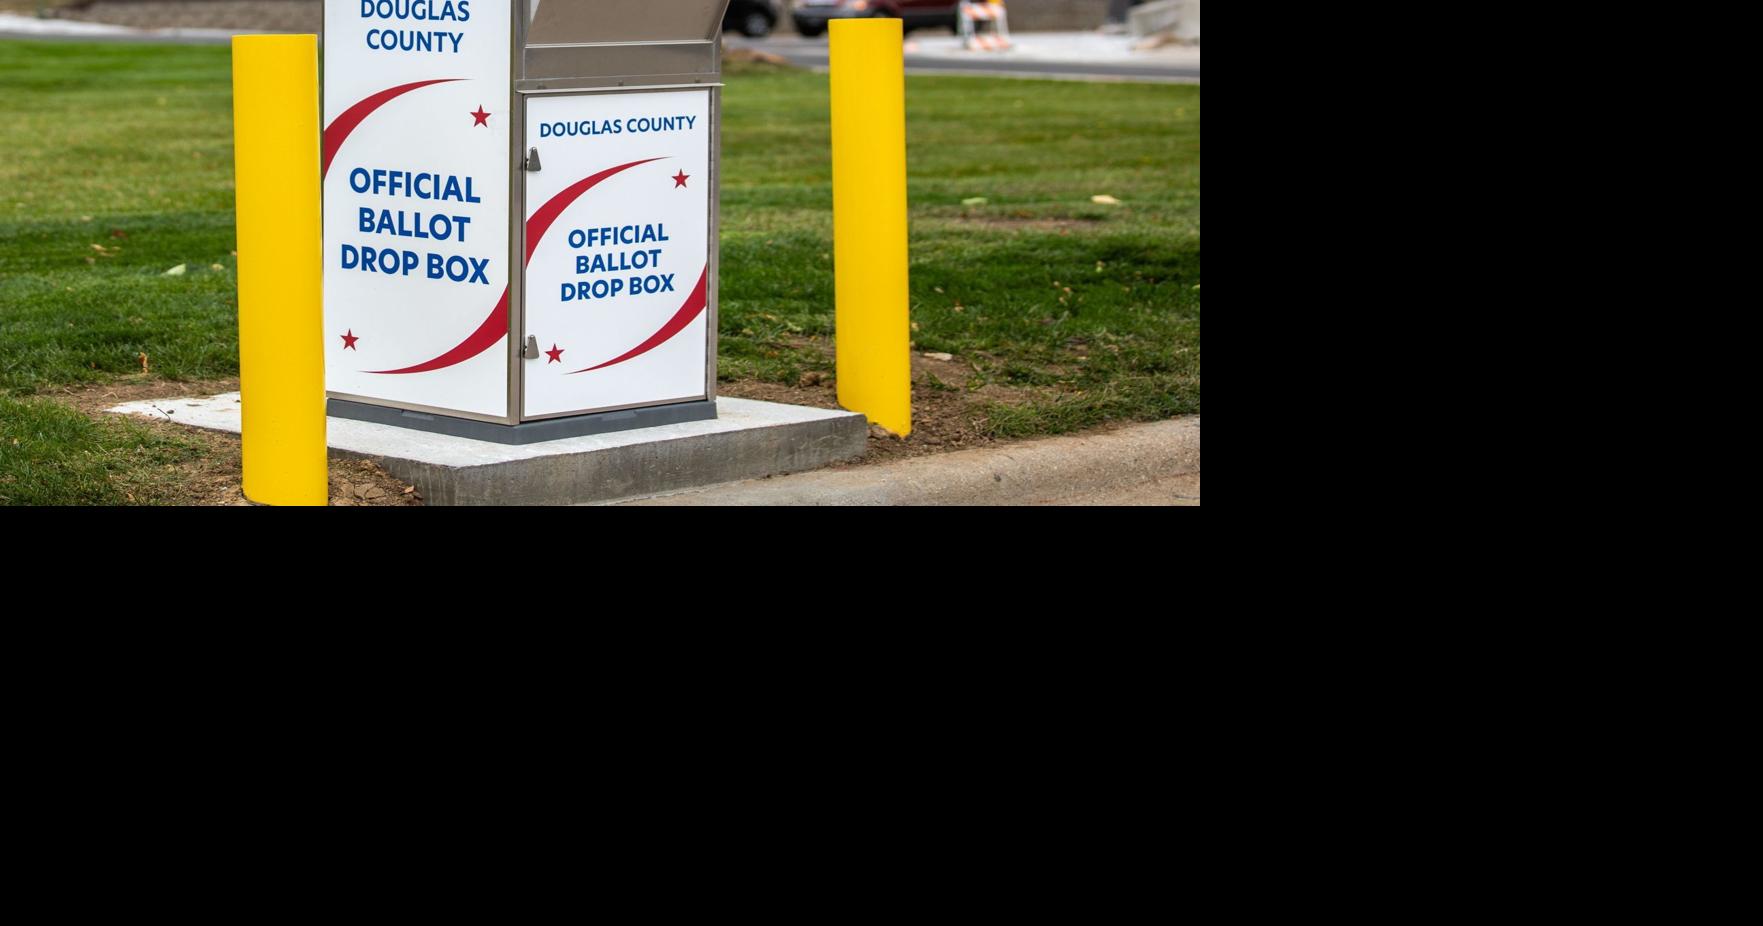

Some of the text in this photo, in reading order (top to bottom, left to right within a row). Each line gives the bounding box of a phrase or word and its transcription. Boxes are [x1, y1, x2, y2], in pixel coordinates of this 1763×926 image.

[360, 0, 470, 22] DOUGLAS
[366, 29, 464, 53] COUNTY
[540, 115, 697, 138] DOUGLAS COUNTY
[349, 168, 481, 204] OFFICIAL
[358, 207, 471, 242] BALLOT
[567, 223, 670, 249] OFFICIAL
[341, 244, 490, 285] DROP BOX
[575, 249, 662, 275] BALLOT
[560, 274, 675, 302] DROP BOX
